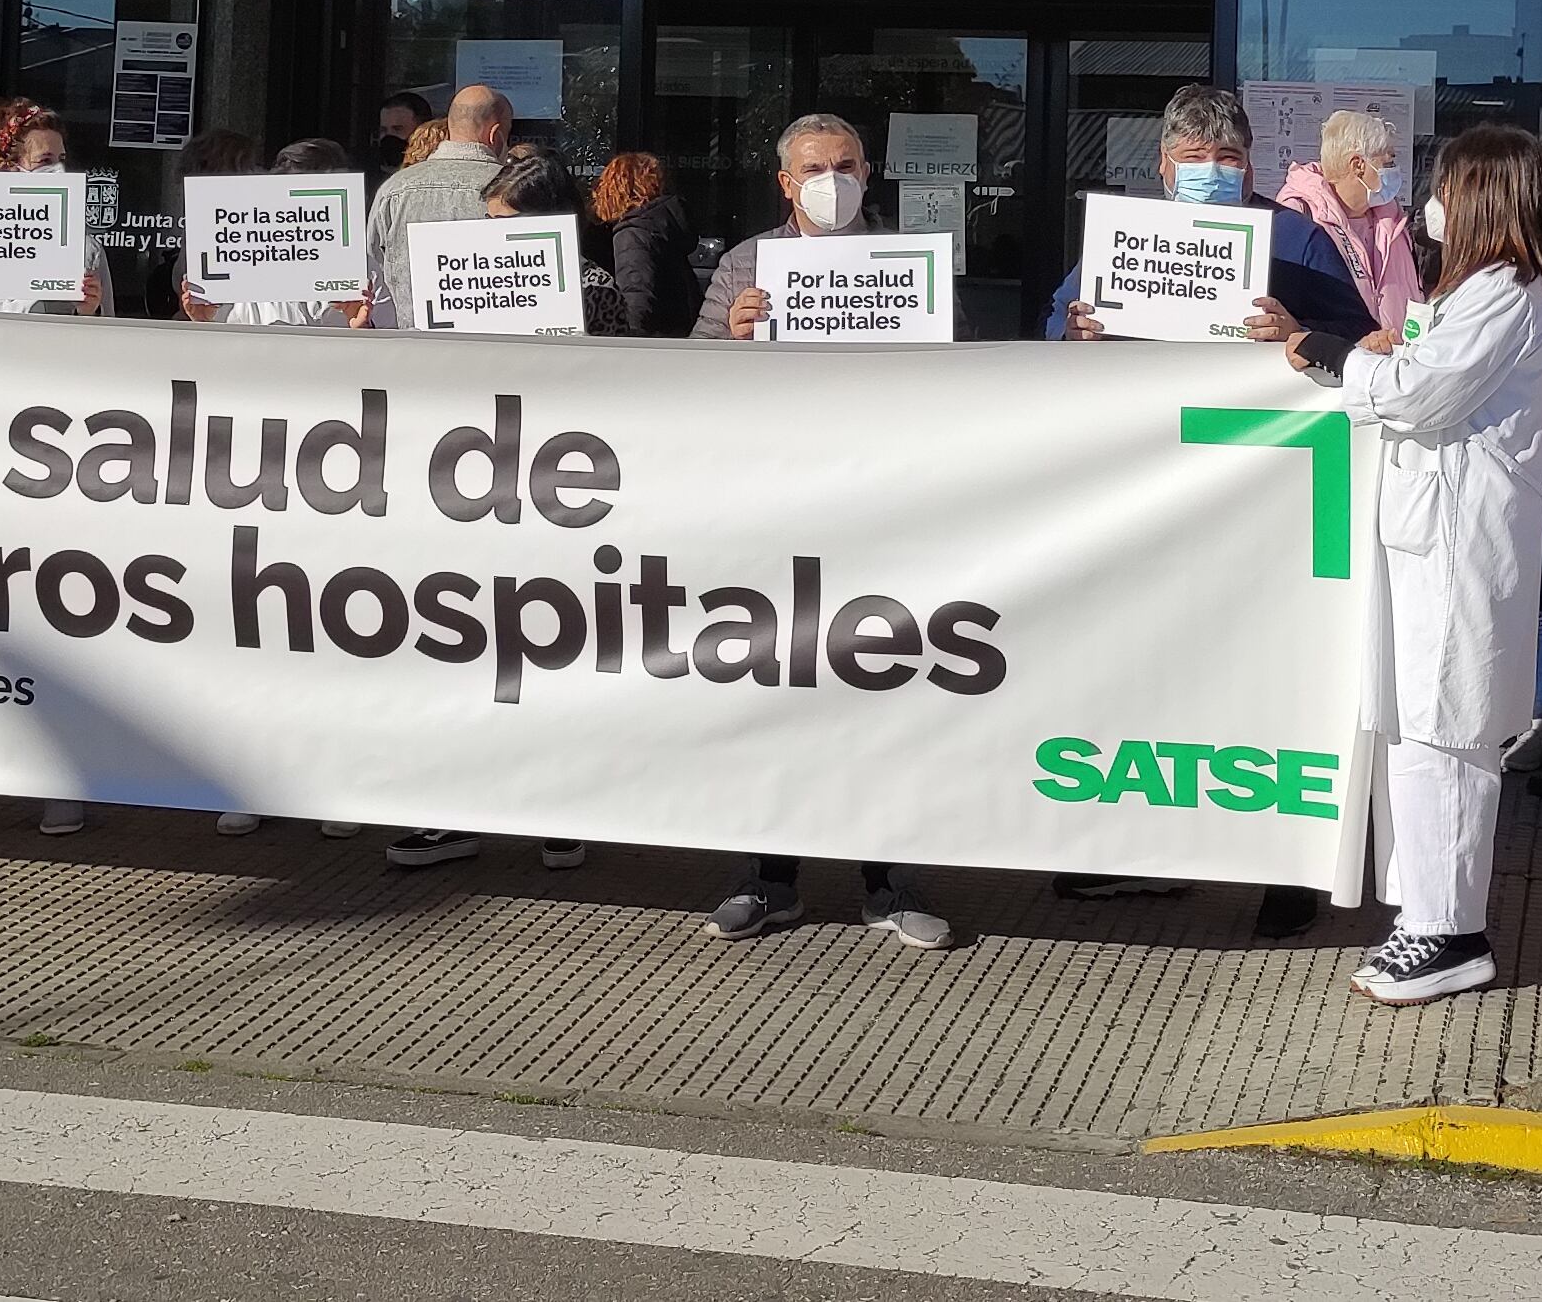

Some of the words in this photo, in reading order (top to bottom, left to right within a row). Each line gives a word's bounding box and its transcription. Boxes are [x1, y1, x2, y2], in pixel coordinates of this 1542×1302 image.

[905, 162, 922, 174] EL
[122, 212, 172, 227] Junta
[216, 209, 248, 224] Por
[254, 207, 270, 223] la
[276, 206, 329, 223] salud
[139, 235, 151, 252] y
[215, 227, 241, 243] de
[247, 226, 334, 242] nuestros
[1114, 231, 1148, 250] Por
[1154, 235, 1170, 253] la
[1176, 239, 1232, 260] salud
[216, 245, 319, 266] hospitales
[438, 255, 468, 271] Por
[474, 253, 489, 269] la
[494, 250, 545, 268] salud
[1112, 252, 1138, 270] de
[1144, 259, 1235, 282] nuestros
[30, 280, 75, 290] SATSE
[315, 280, 359, 291] SATSE
[439, 274, 463, 290] de
[468, 272, 551, 289] nuestros
[788, 272, 824, 288] Por
[830, 270, 848, 288] la
[854, 269, 913, 287] salud
[1111, 272, 1217, 300] hospitales
[440, 291, 537, 314] hospitales
[787, 291, 813, 308] de
[818, 291, 918, 309] nuestros
[787, 311, 900, 335] hospitales
[1209, 324, 1249, 338] SATS
[2, 380, 388, 517] salud
[429, 394, 620, 528] de
[232, 525, 1006, 704] hospitales
[1032, 737, 1339, 820] SATSE
